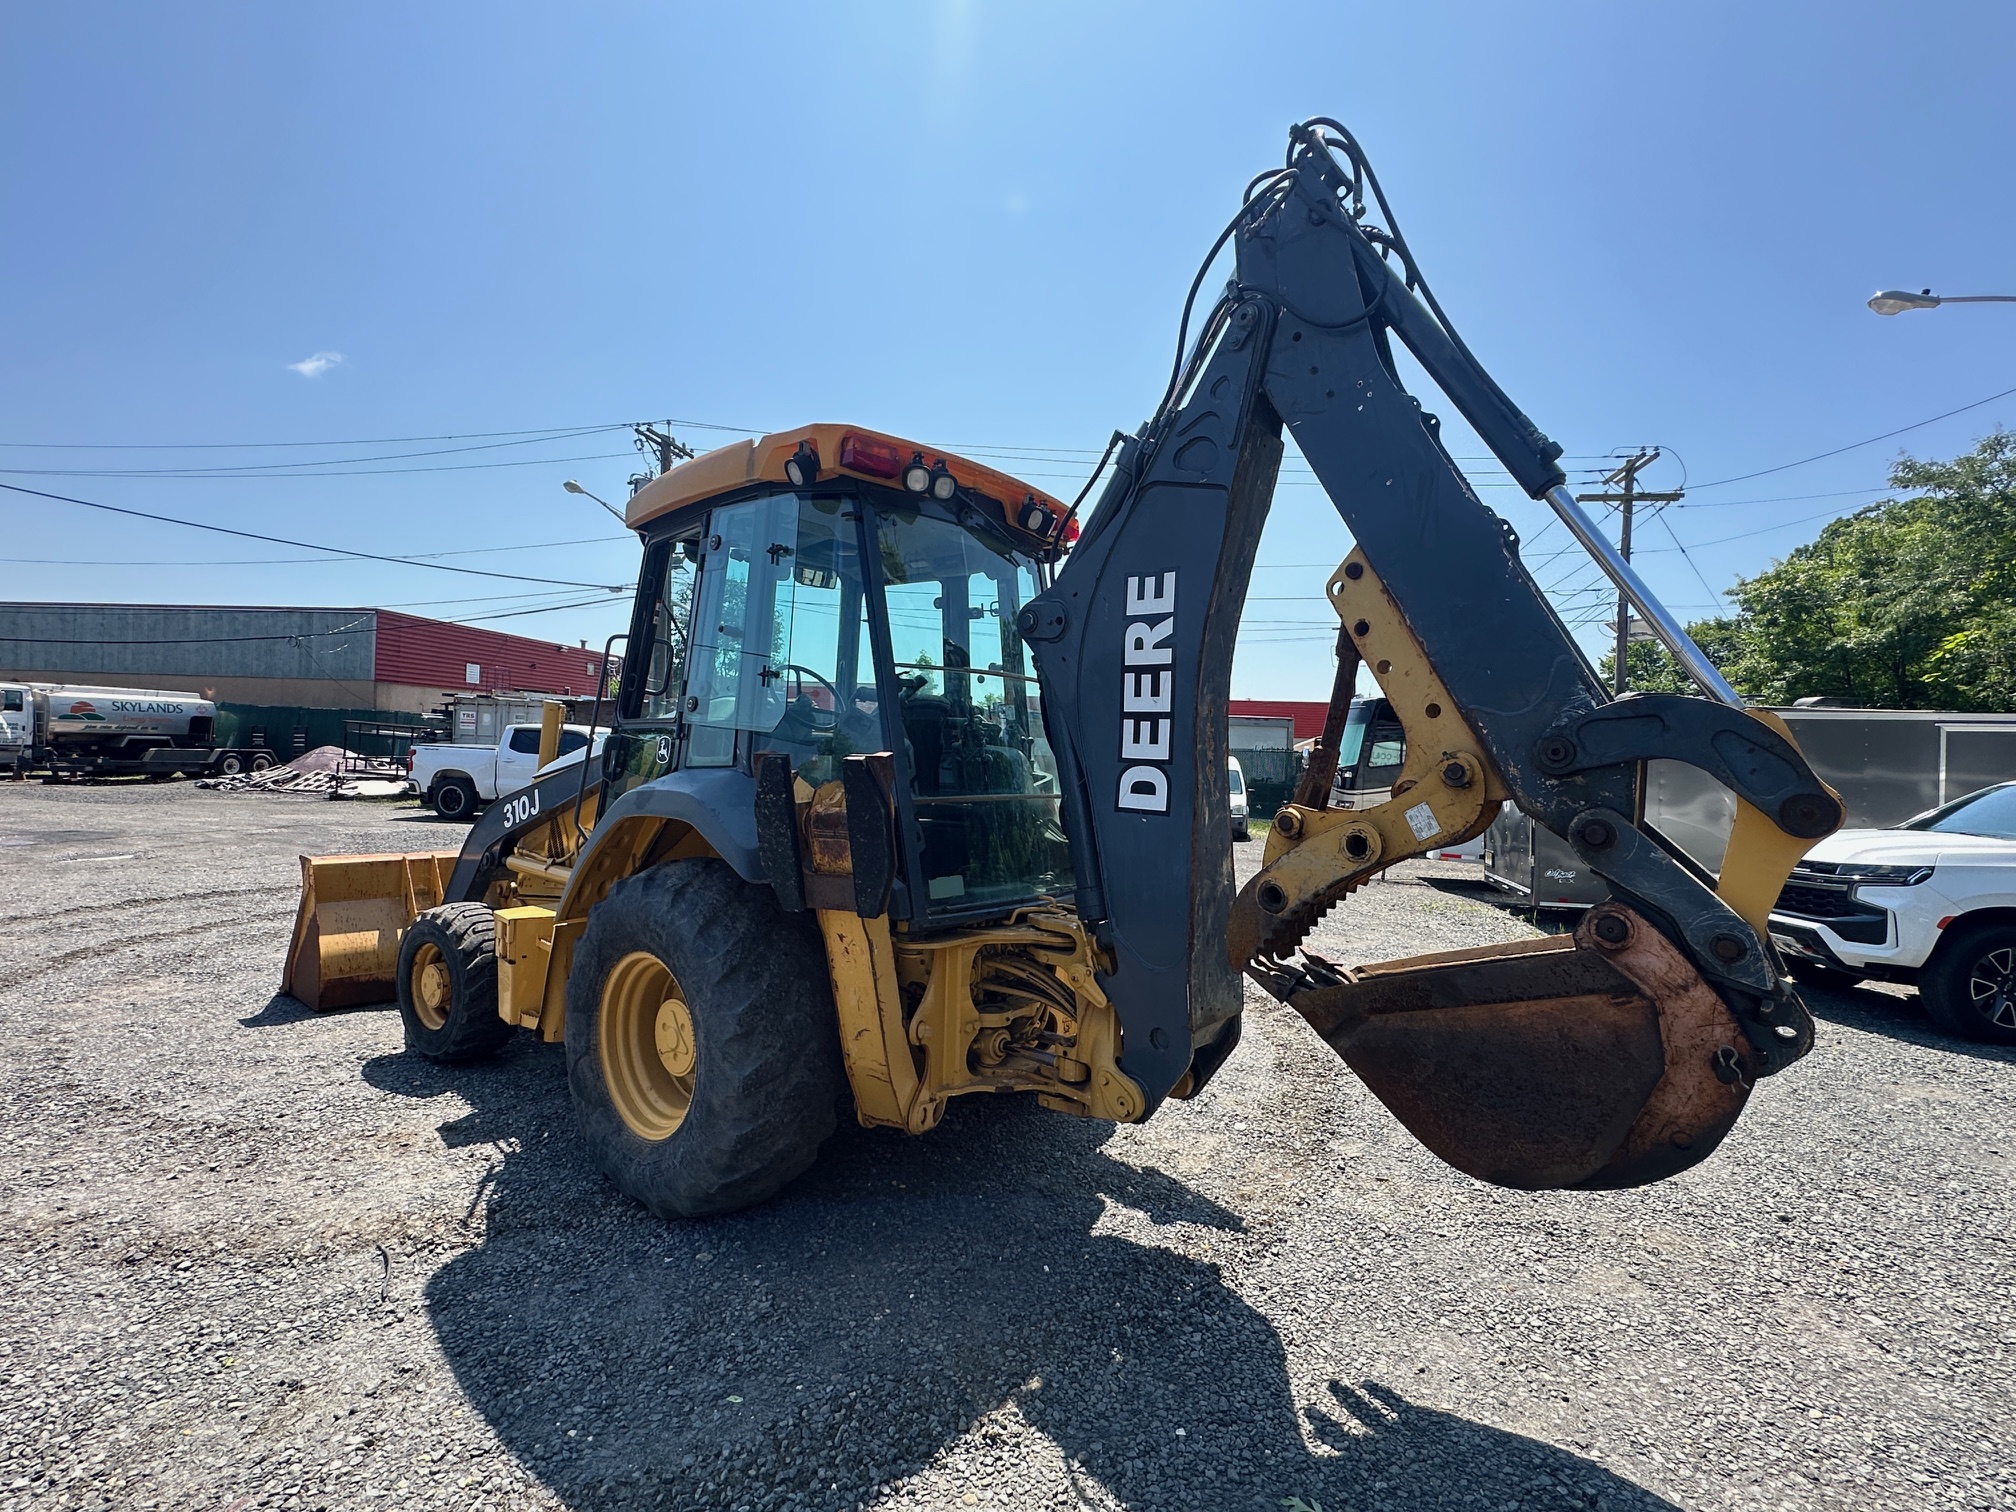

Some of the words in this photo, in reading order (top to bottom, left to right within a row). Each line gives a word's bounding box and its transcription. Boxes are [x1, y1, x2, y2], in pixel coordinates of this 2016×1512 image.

[111, 701, 184, 714] SKYLANDS
[1118, 571, 1176, 812] DEERE
[503, 789, 540, 828] 310J
